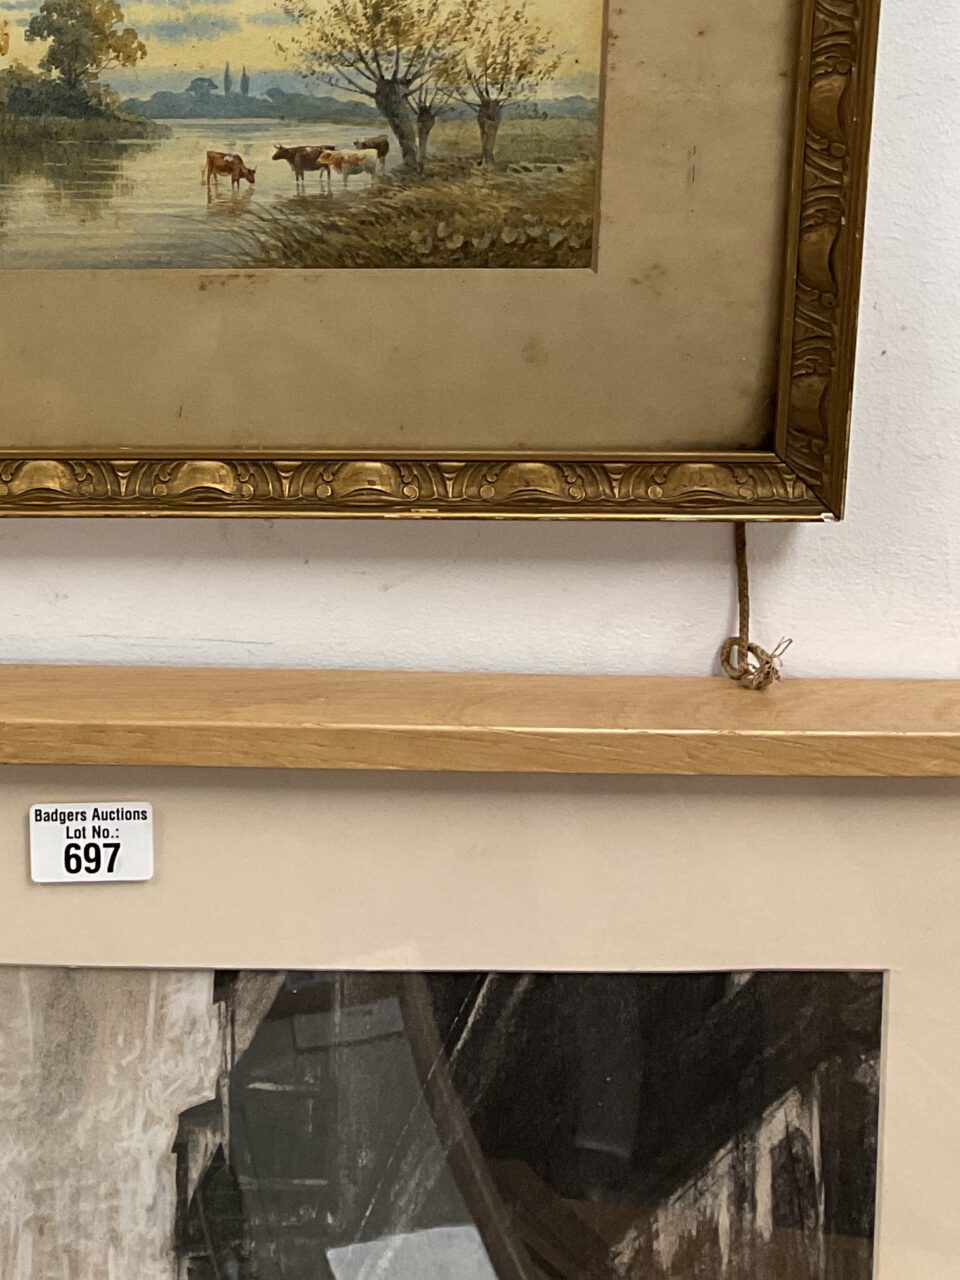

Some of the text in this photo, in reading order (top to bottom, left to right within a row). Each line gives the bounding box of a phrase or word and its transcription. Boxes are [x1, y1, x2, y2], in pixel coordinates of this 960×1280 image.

[34, 808, 148, 824] Badgers Auctions
[66, 825, 119, 839] Lot No.:
[64, 842, 121, 874] 697
